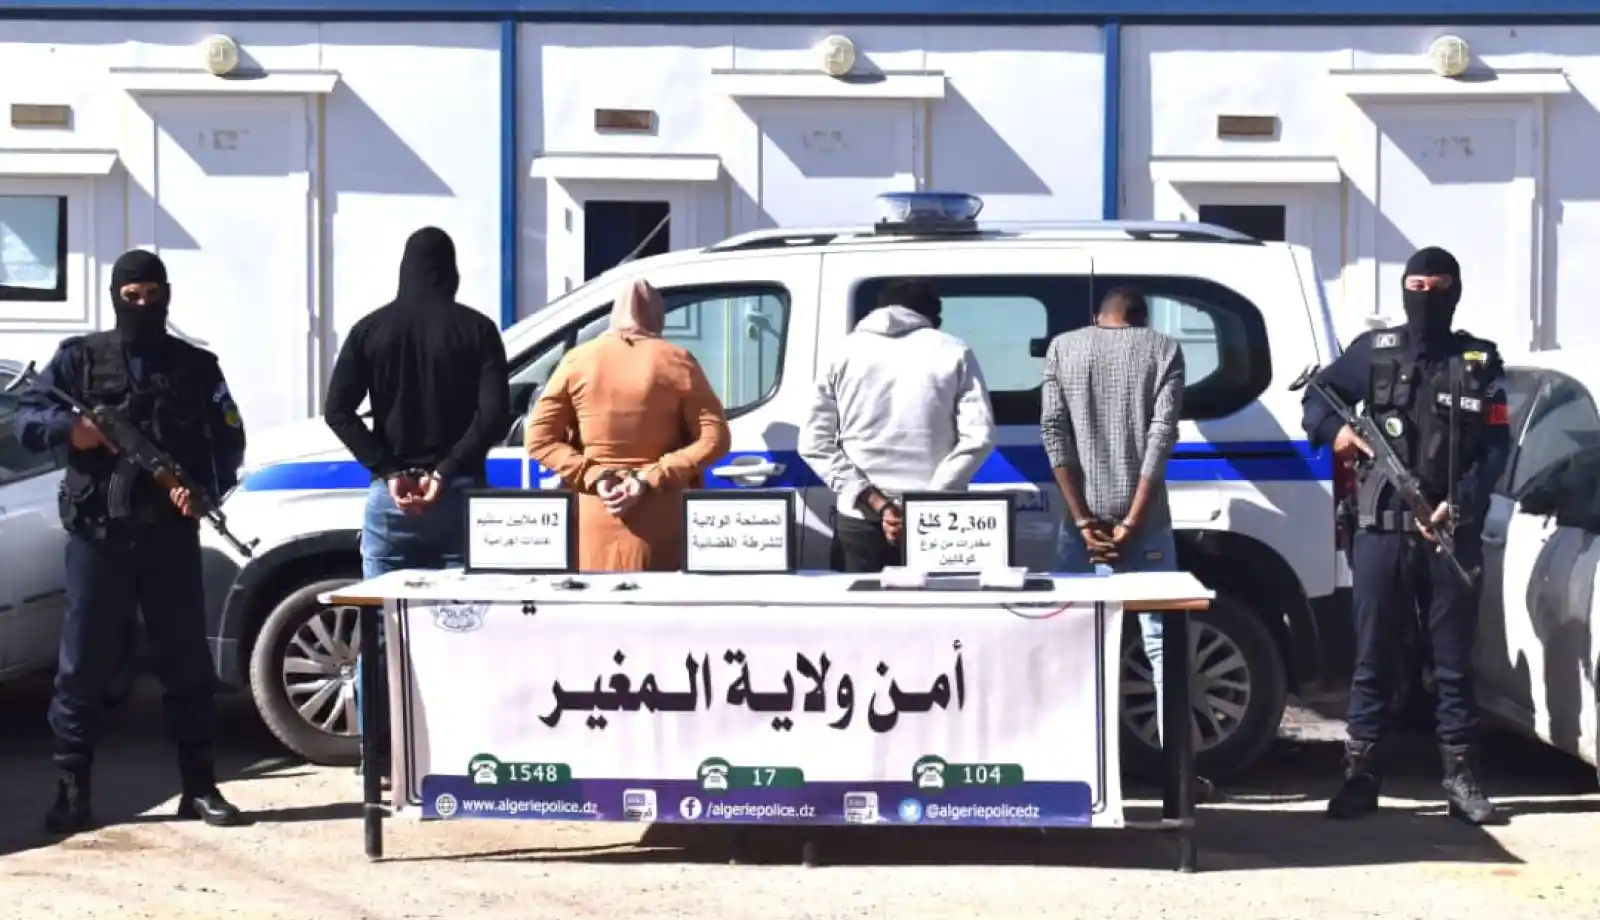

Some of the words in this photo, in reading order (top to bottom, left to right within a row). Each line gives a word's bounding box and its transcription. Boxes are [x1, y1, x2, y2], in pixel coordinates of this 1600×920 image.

[541, 511, 559, 527] 02
[735, 511, 782, 526] المصلحة
[916, 511, 941, 535] كلغ
[920, 539, 938, 552] نوع
[940, 540, 954, 551] من
[955, 539, 992, 550] مخدرات
[537, 649, 712, 730] المغير
[723, 648, 854, 732] ولاية
[867, 638, 965, 733] أمن
[508, 764, 558, 782] 1548
[752, 768, 777, 787] 17
[963, 765, 1002, 784] 104
[462, 797, 599, 815] www.algeriepolice.dz
[706, 801, 817, 819] /algeriepolice.dz
[925, 802, 1041, 821] @algeriepolicedz
